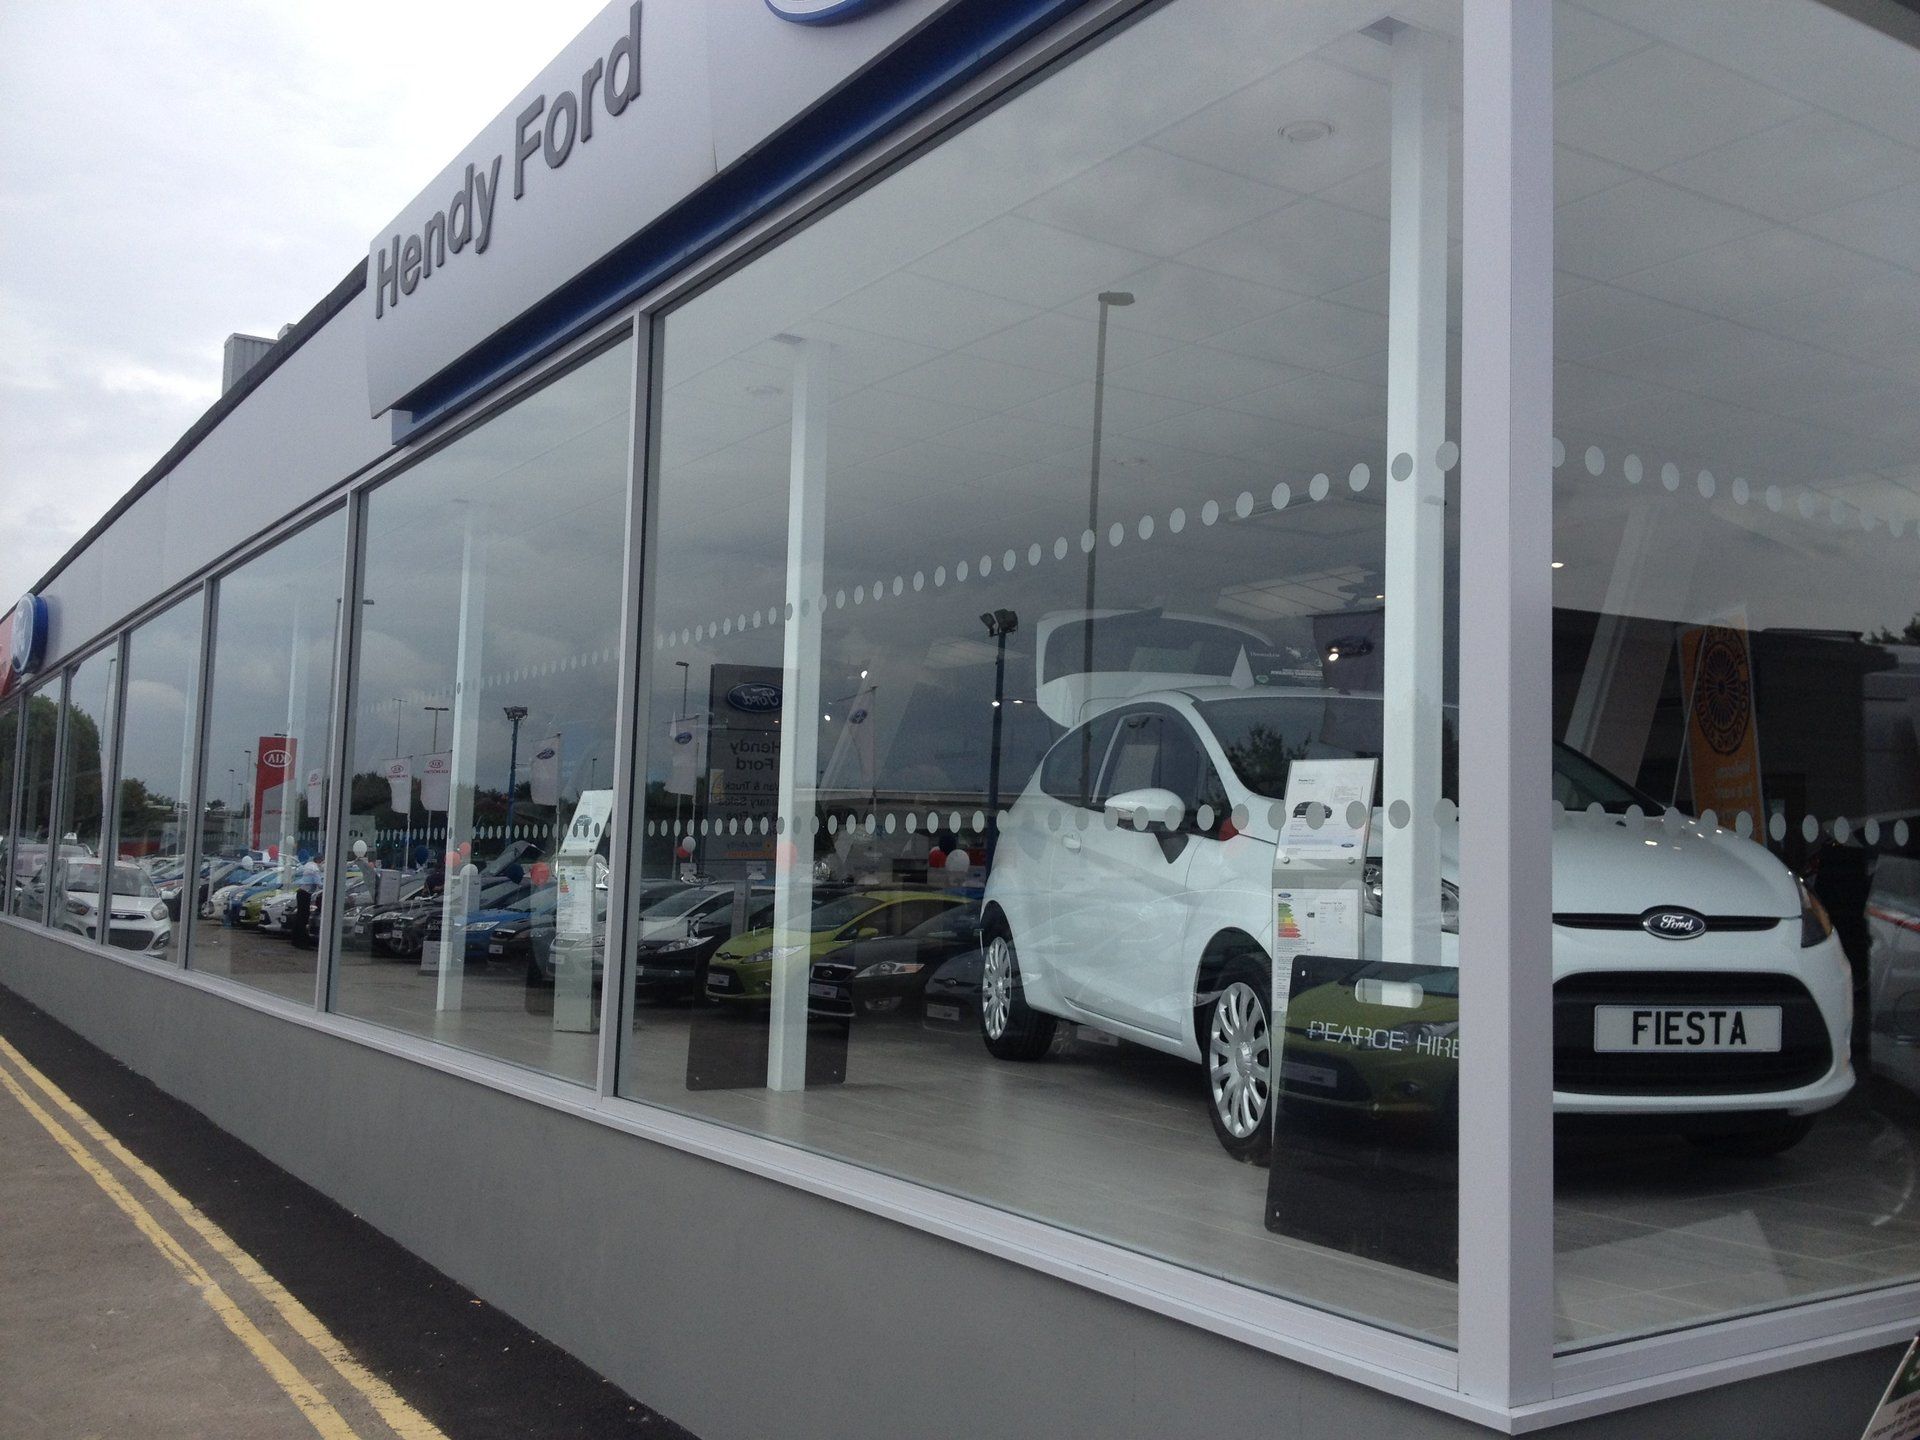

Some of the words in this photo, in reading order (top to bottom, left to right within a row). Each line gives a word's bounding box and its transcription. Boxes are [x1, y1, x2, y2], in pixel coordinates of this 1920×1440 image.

[375, 155, 502, 320] Hendy
[514, 0, 642, 200] Ford
[1660, 915, 1694, 932] Ford
[1307, 1020, 1403, 1052] PEARCE
[1632, 1010, 1747, 1046] FIESTA
